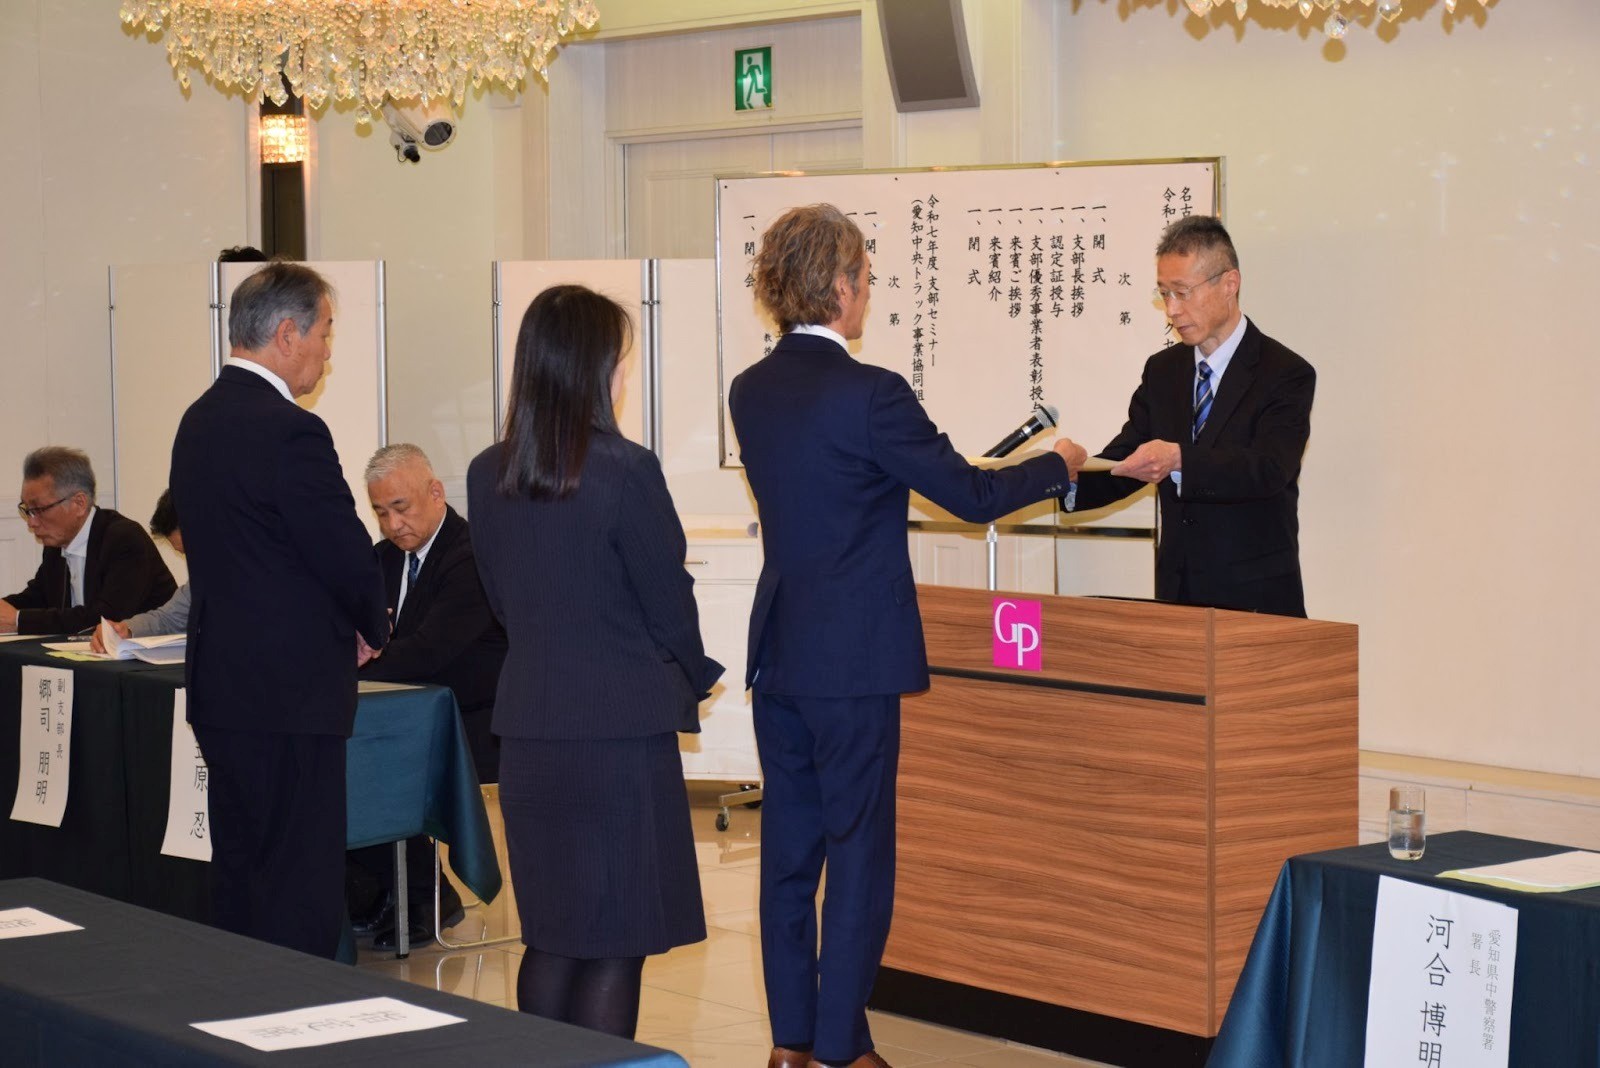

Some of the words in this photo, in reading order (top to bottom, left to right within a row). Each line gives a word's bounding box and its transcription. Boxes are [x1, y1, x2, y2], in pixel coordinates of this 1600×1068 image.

[994, 601, 1039, 666] GP
[190, 811, 205, 839] 忍
[1424, 914, 1455, 987] 河合
[1469, 932, 1484, 977] 署長
[1482, 929, 1501, 1051] 愛知県中警察署
[1419, 1000, 1447, 1068] 博明
